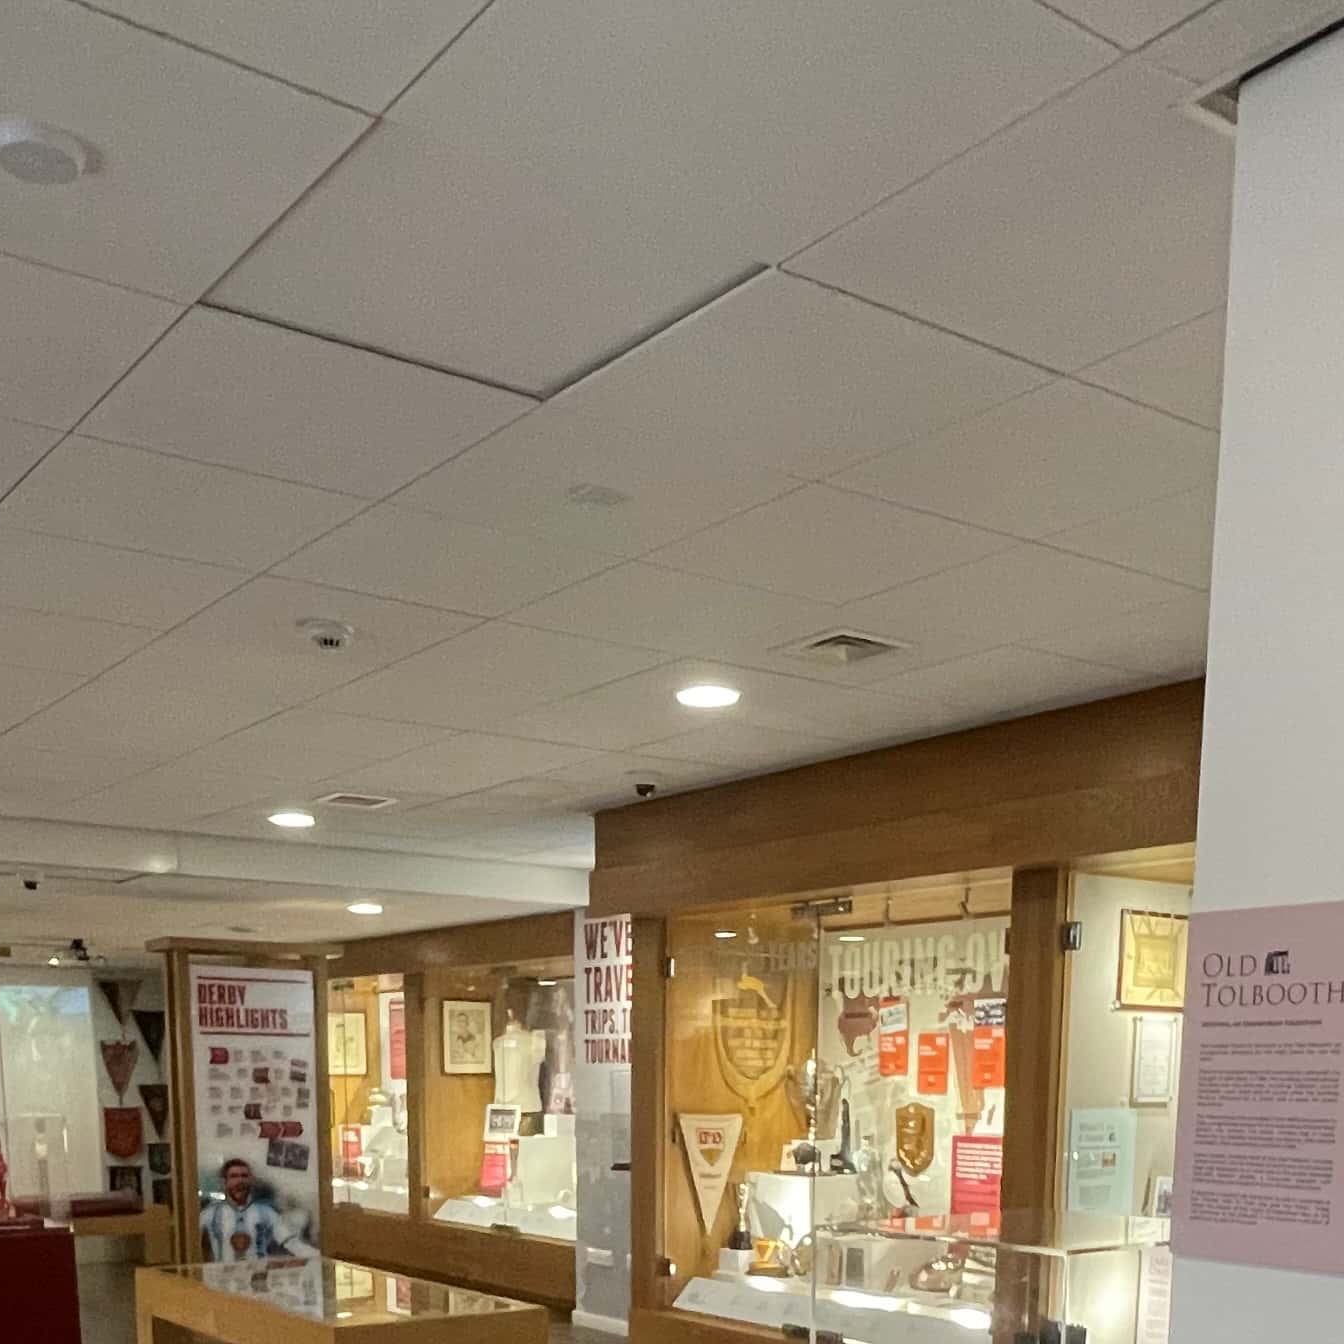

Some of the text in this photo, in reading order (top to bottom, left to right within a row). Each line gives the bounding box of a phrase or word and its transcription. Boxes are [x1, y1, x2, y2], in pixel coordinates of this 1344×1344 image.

[1203, 952, 1257, 978] OLD
[197, 983, 247, 1006] DERBY
[198, 1006, 288, 1029] HIGHLIGHTS
